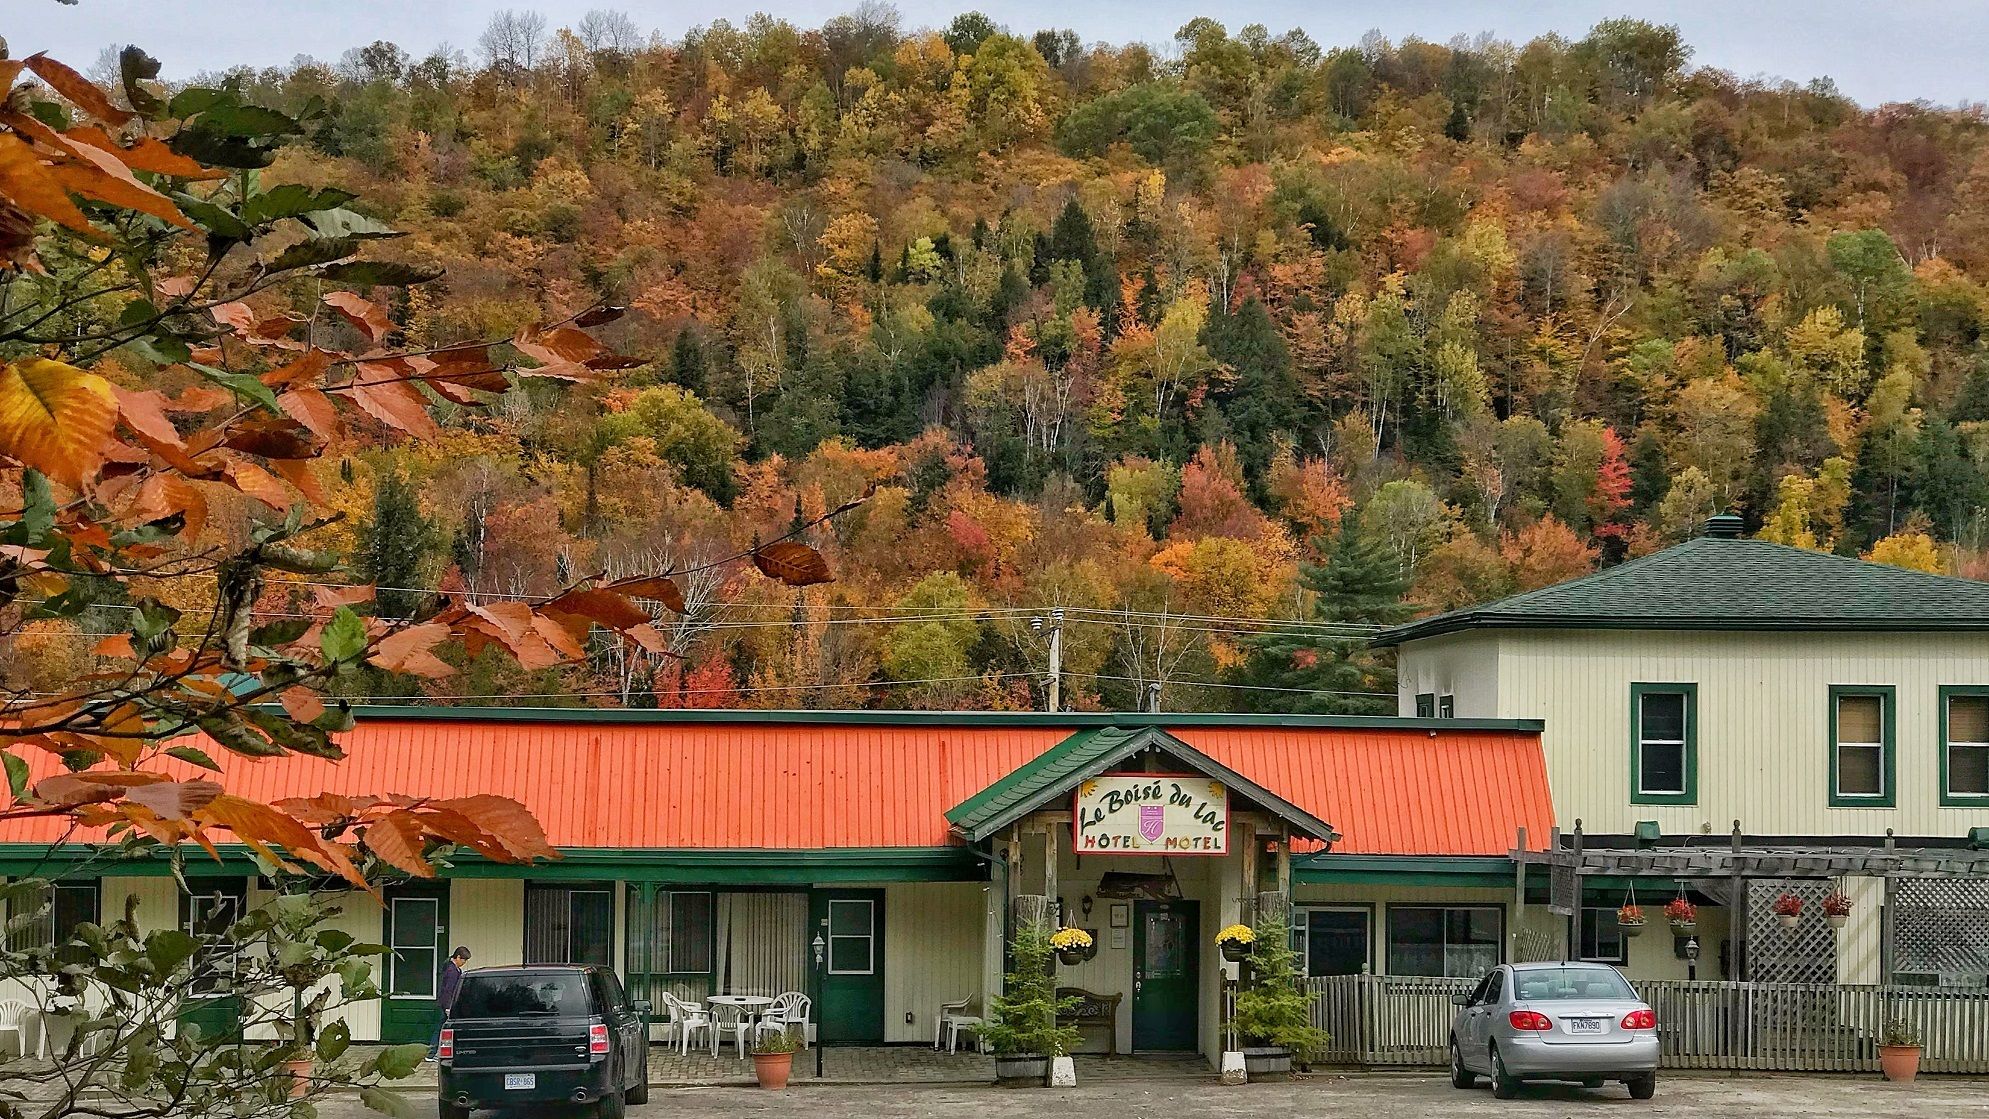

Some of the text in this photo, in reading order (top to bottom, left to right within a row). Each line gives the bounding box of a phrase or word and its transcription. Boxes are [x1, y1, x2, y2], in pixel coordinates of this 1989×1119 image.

[1080, 807, 1105, 836] Le
[1099, 780, 1163, 814] Boisé
[1169, 783, 1193, 808] du
[1084, 833, 1222, 850] HÔTEL MOTEL
